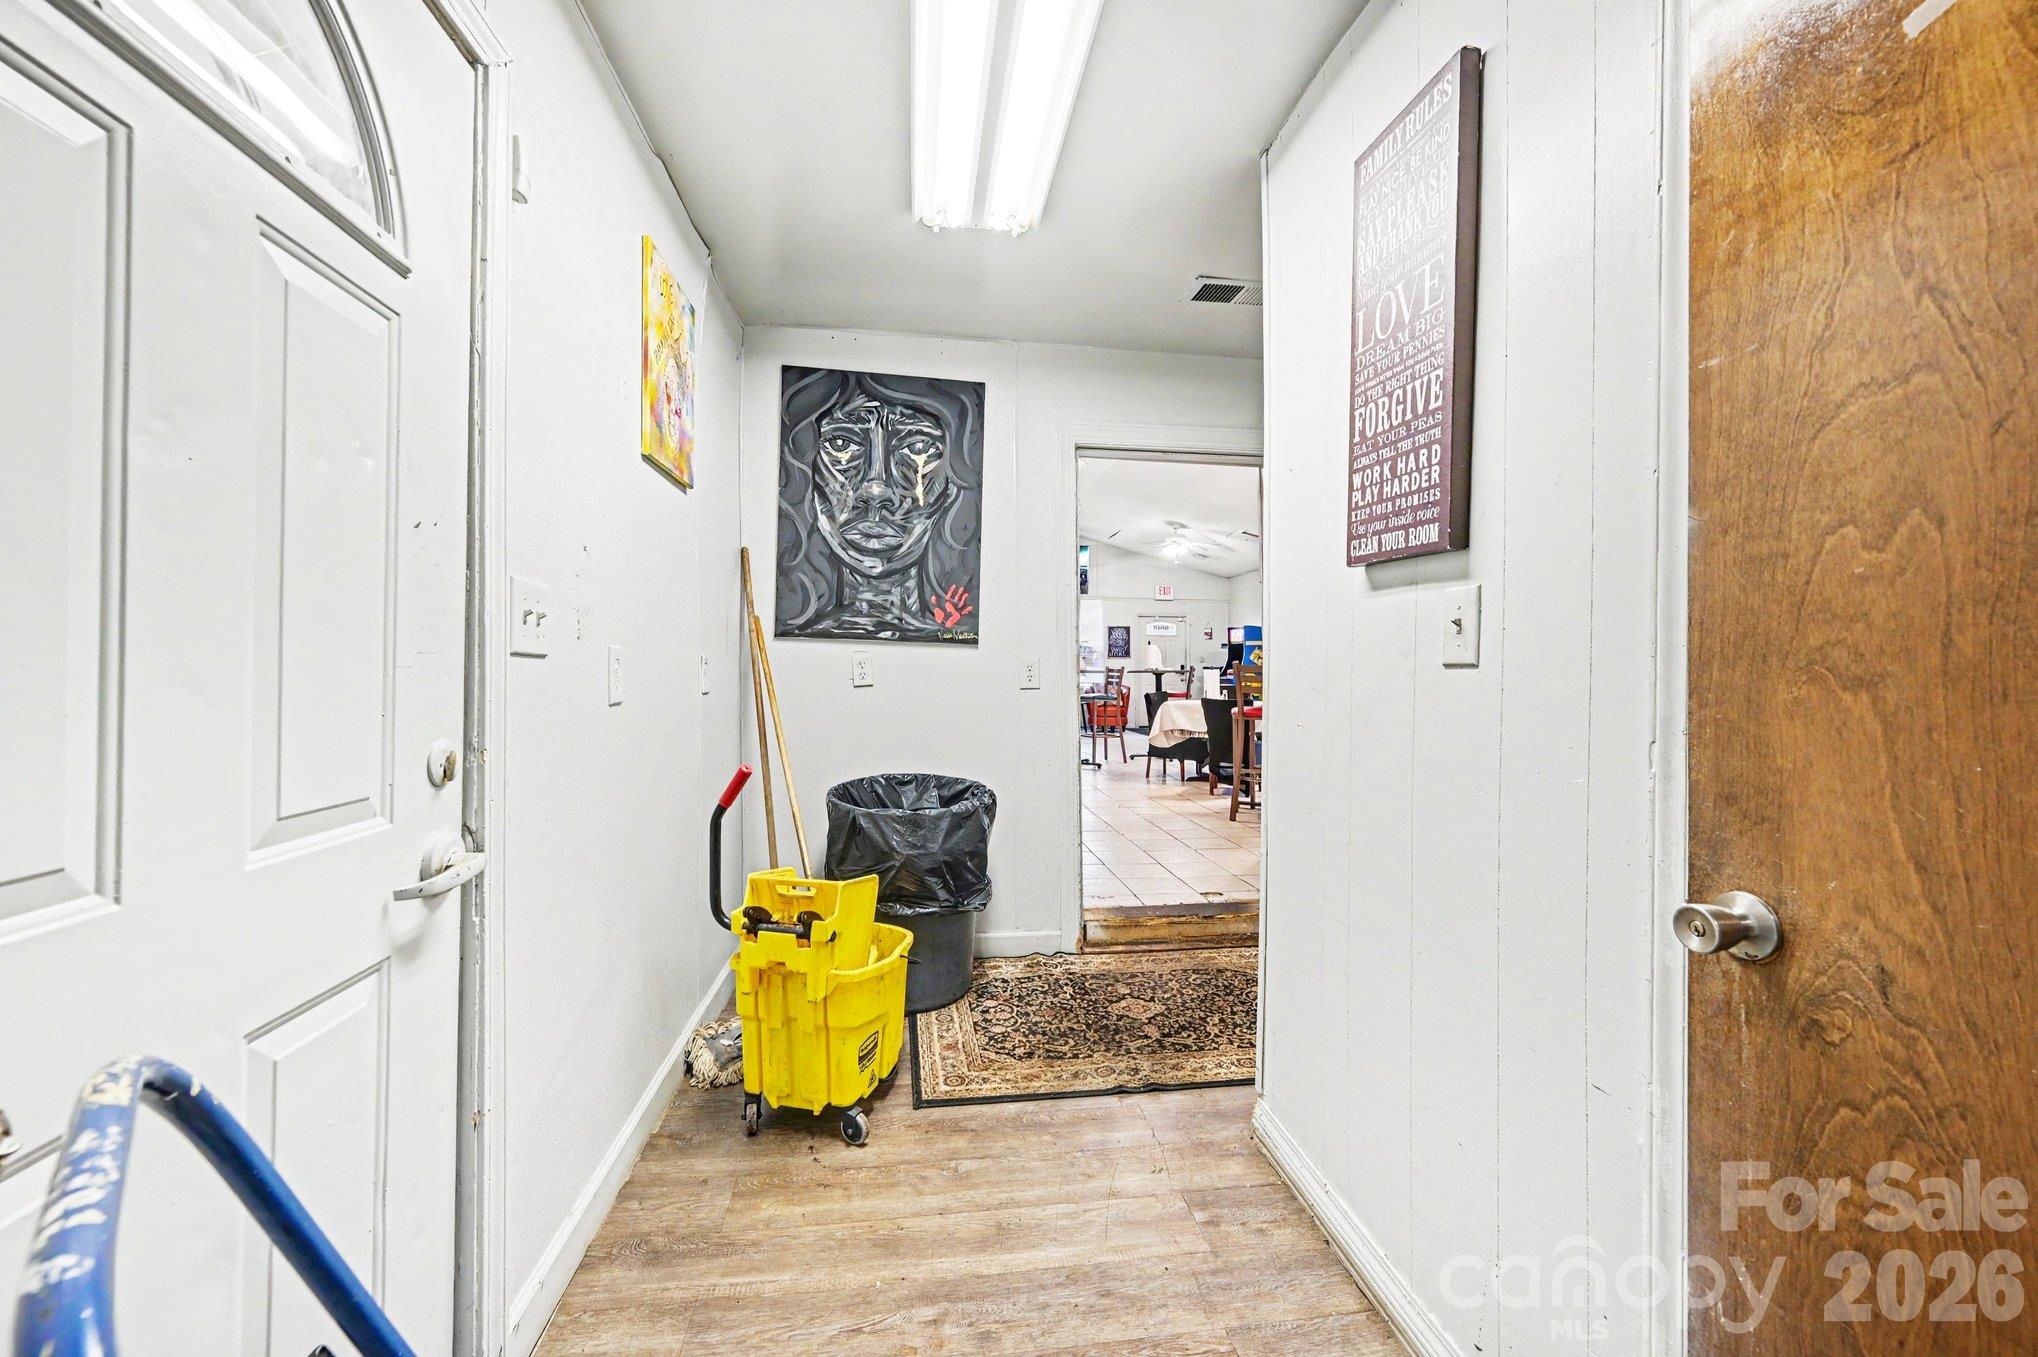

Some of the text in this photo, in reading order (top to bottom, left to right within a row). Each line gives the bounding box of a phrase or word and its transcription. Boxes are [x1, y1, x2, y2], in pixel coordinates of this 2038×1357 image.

[1361, 72, 1451, 186] FAMILY RULES
[1383, 164, 1405, 198] NICE
[1411, 148, 1421, 171] BE
[1426, 120, 1450, 158] KIND
[1359, 158, 1448, 256] SAY PLEASE
[1359, 187, 1447, 276] AND THANK YOU
[1356, 253, 1444, 354] LOVE
[1355, 324, 1444, 385] SAVE YOUR PENNIES
[1356, 328, 1410, 371] DREAM
[1415, 305, 1445, 336] BIG
[1354, 368, 1443, 442] FORGIVE
[1355, 351, 1444, 407] DO THE RIGHT THING
[1353, 410, 1442, 455] EAT YOUR PEAS
[1353, 426, 1441, 469] ALWAYS TELL THE TRUTH
[1352, 465, 1440, 508] PLAY HARDER
[1353, 443, 1440, 490] WORK HARD
[1351, 488, 1440, 520] KEEP YOUR PROMISES
[1351, 502, 1440, 536] Use your inside voice
[1351, 523, 1439, 556] CLEAN YOUR ROOM
